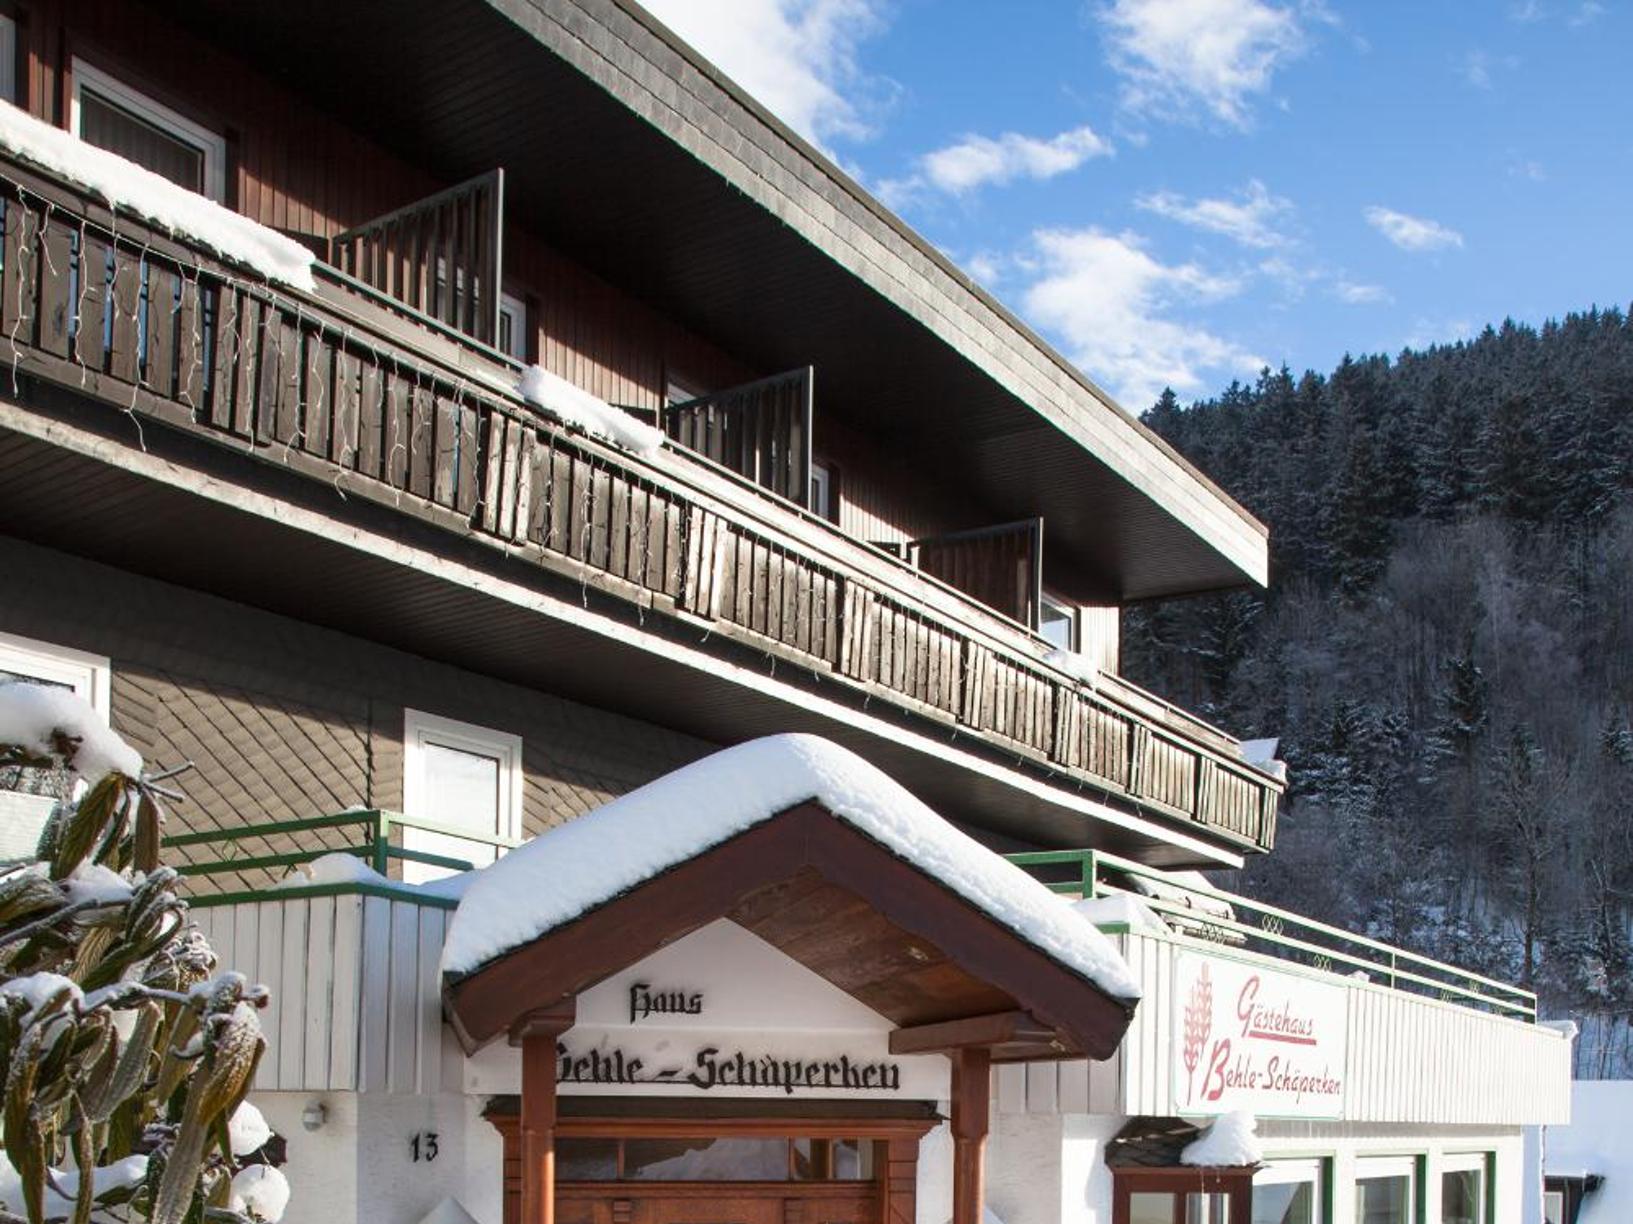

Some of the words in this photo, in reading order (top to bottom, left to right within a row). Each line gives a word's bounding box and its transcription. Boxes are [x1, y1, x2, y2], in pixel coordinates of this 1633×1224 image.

[630, 983, 704, 1024] Haus
[1237, 975, 1313, 1038] Gästehaus
[410, 1132, 440, 1164] 13
